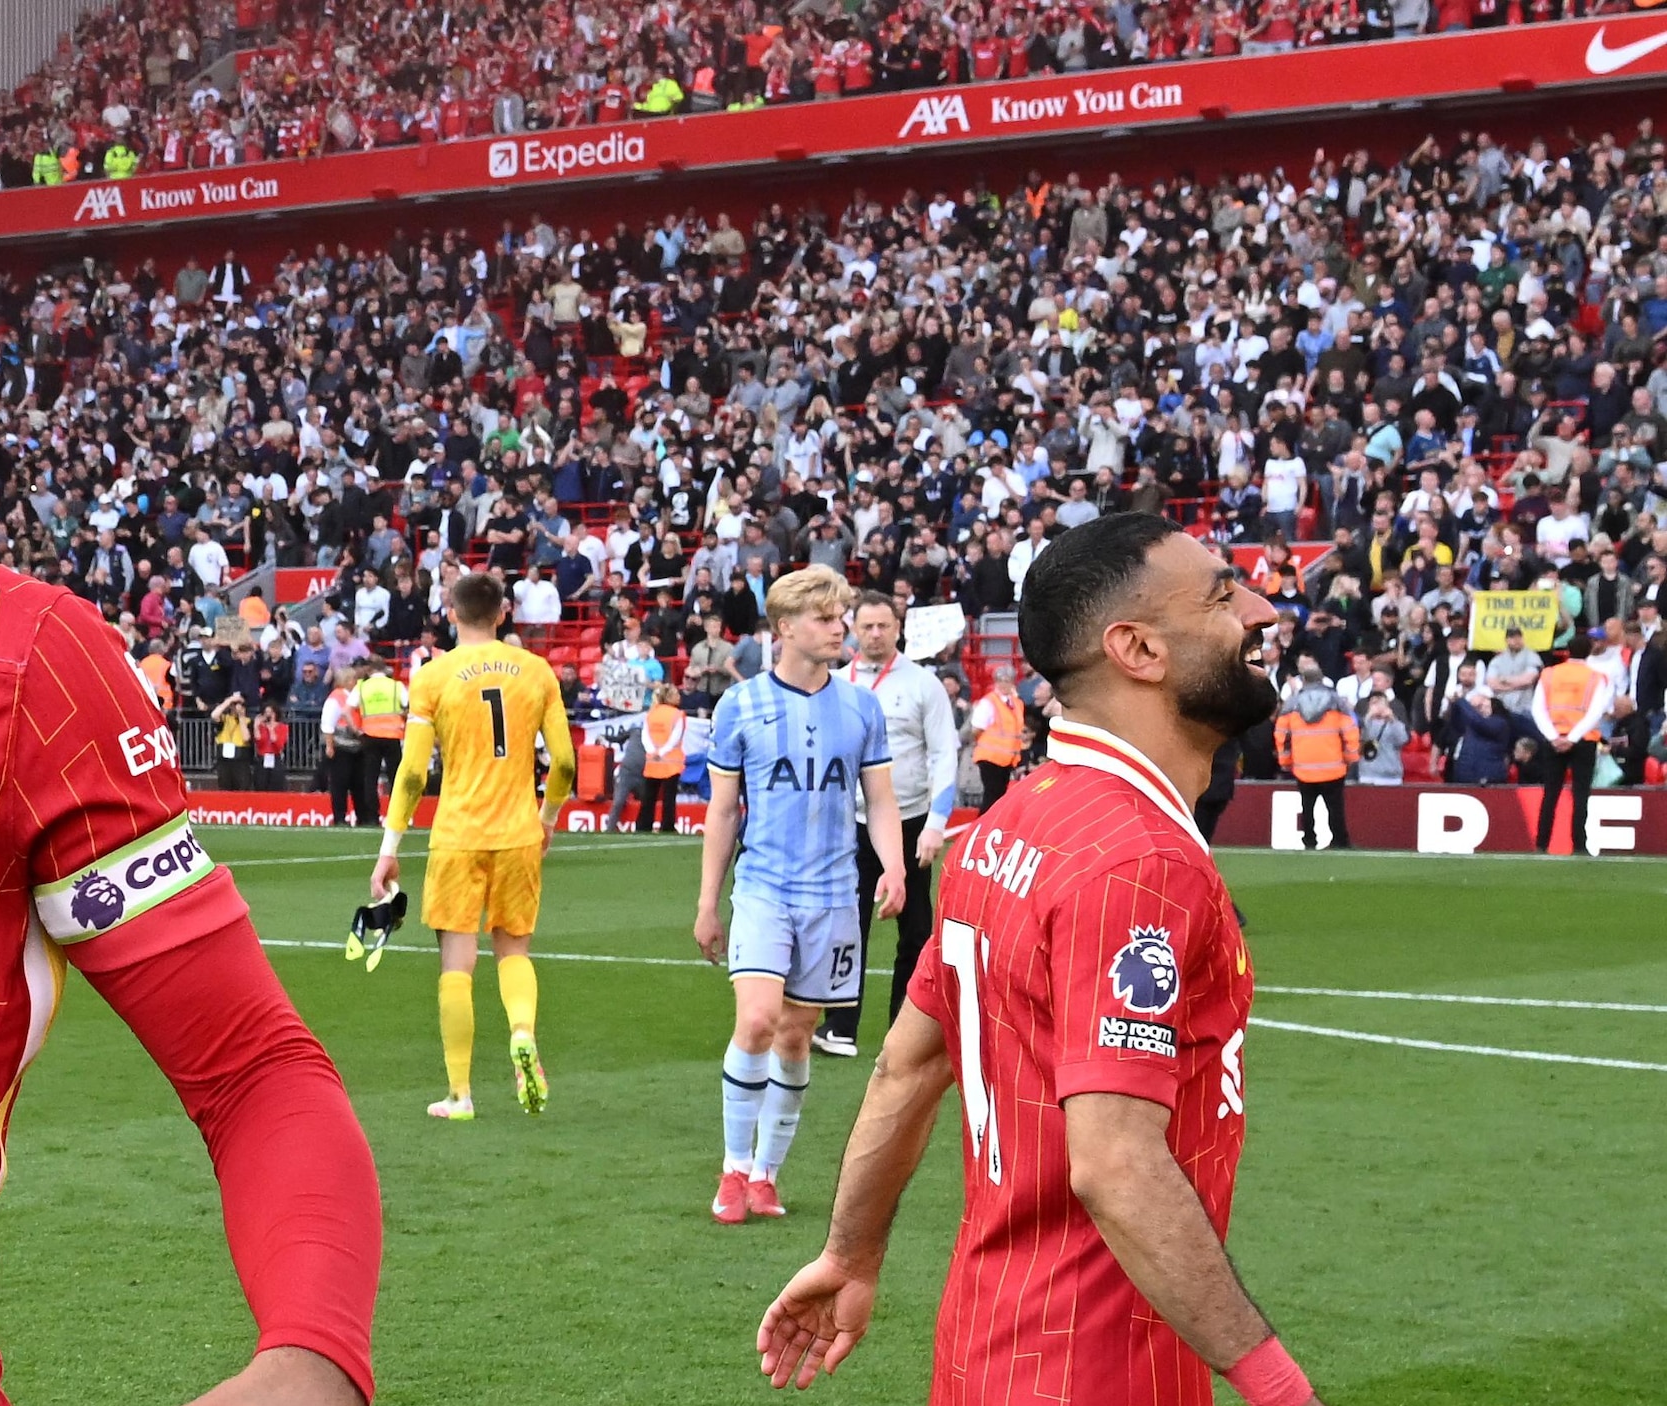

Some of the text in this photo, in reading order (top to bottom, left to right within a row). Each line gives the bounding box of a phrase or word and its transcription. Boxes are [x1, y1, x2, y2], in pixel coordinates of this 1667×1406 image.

[898, 82, 1182, 137] AXA Know You Can
[524, 131, 645, 176] Expedia
[74, 176, 279, 222] AXA Know You Can
[457, 661, 520, 681] VICARIO
[481, 688, 506, 758] 1
[767, 757, 846, 791] AIA
[830, 944, 855, 980] 15
[1098, 1031, 1127, 1047] for
[1099, 1016, 1172, 1043] No room
